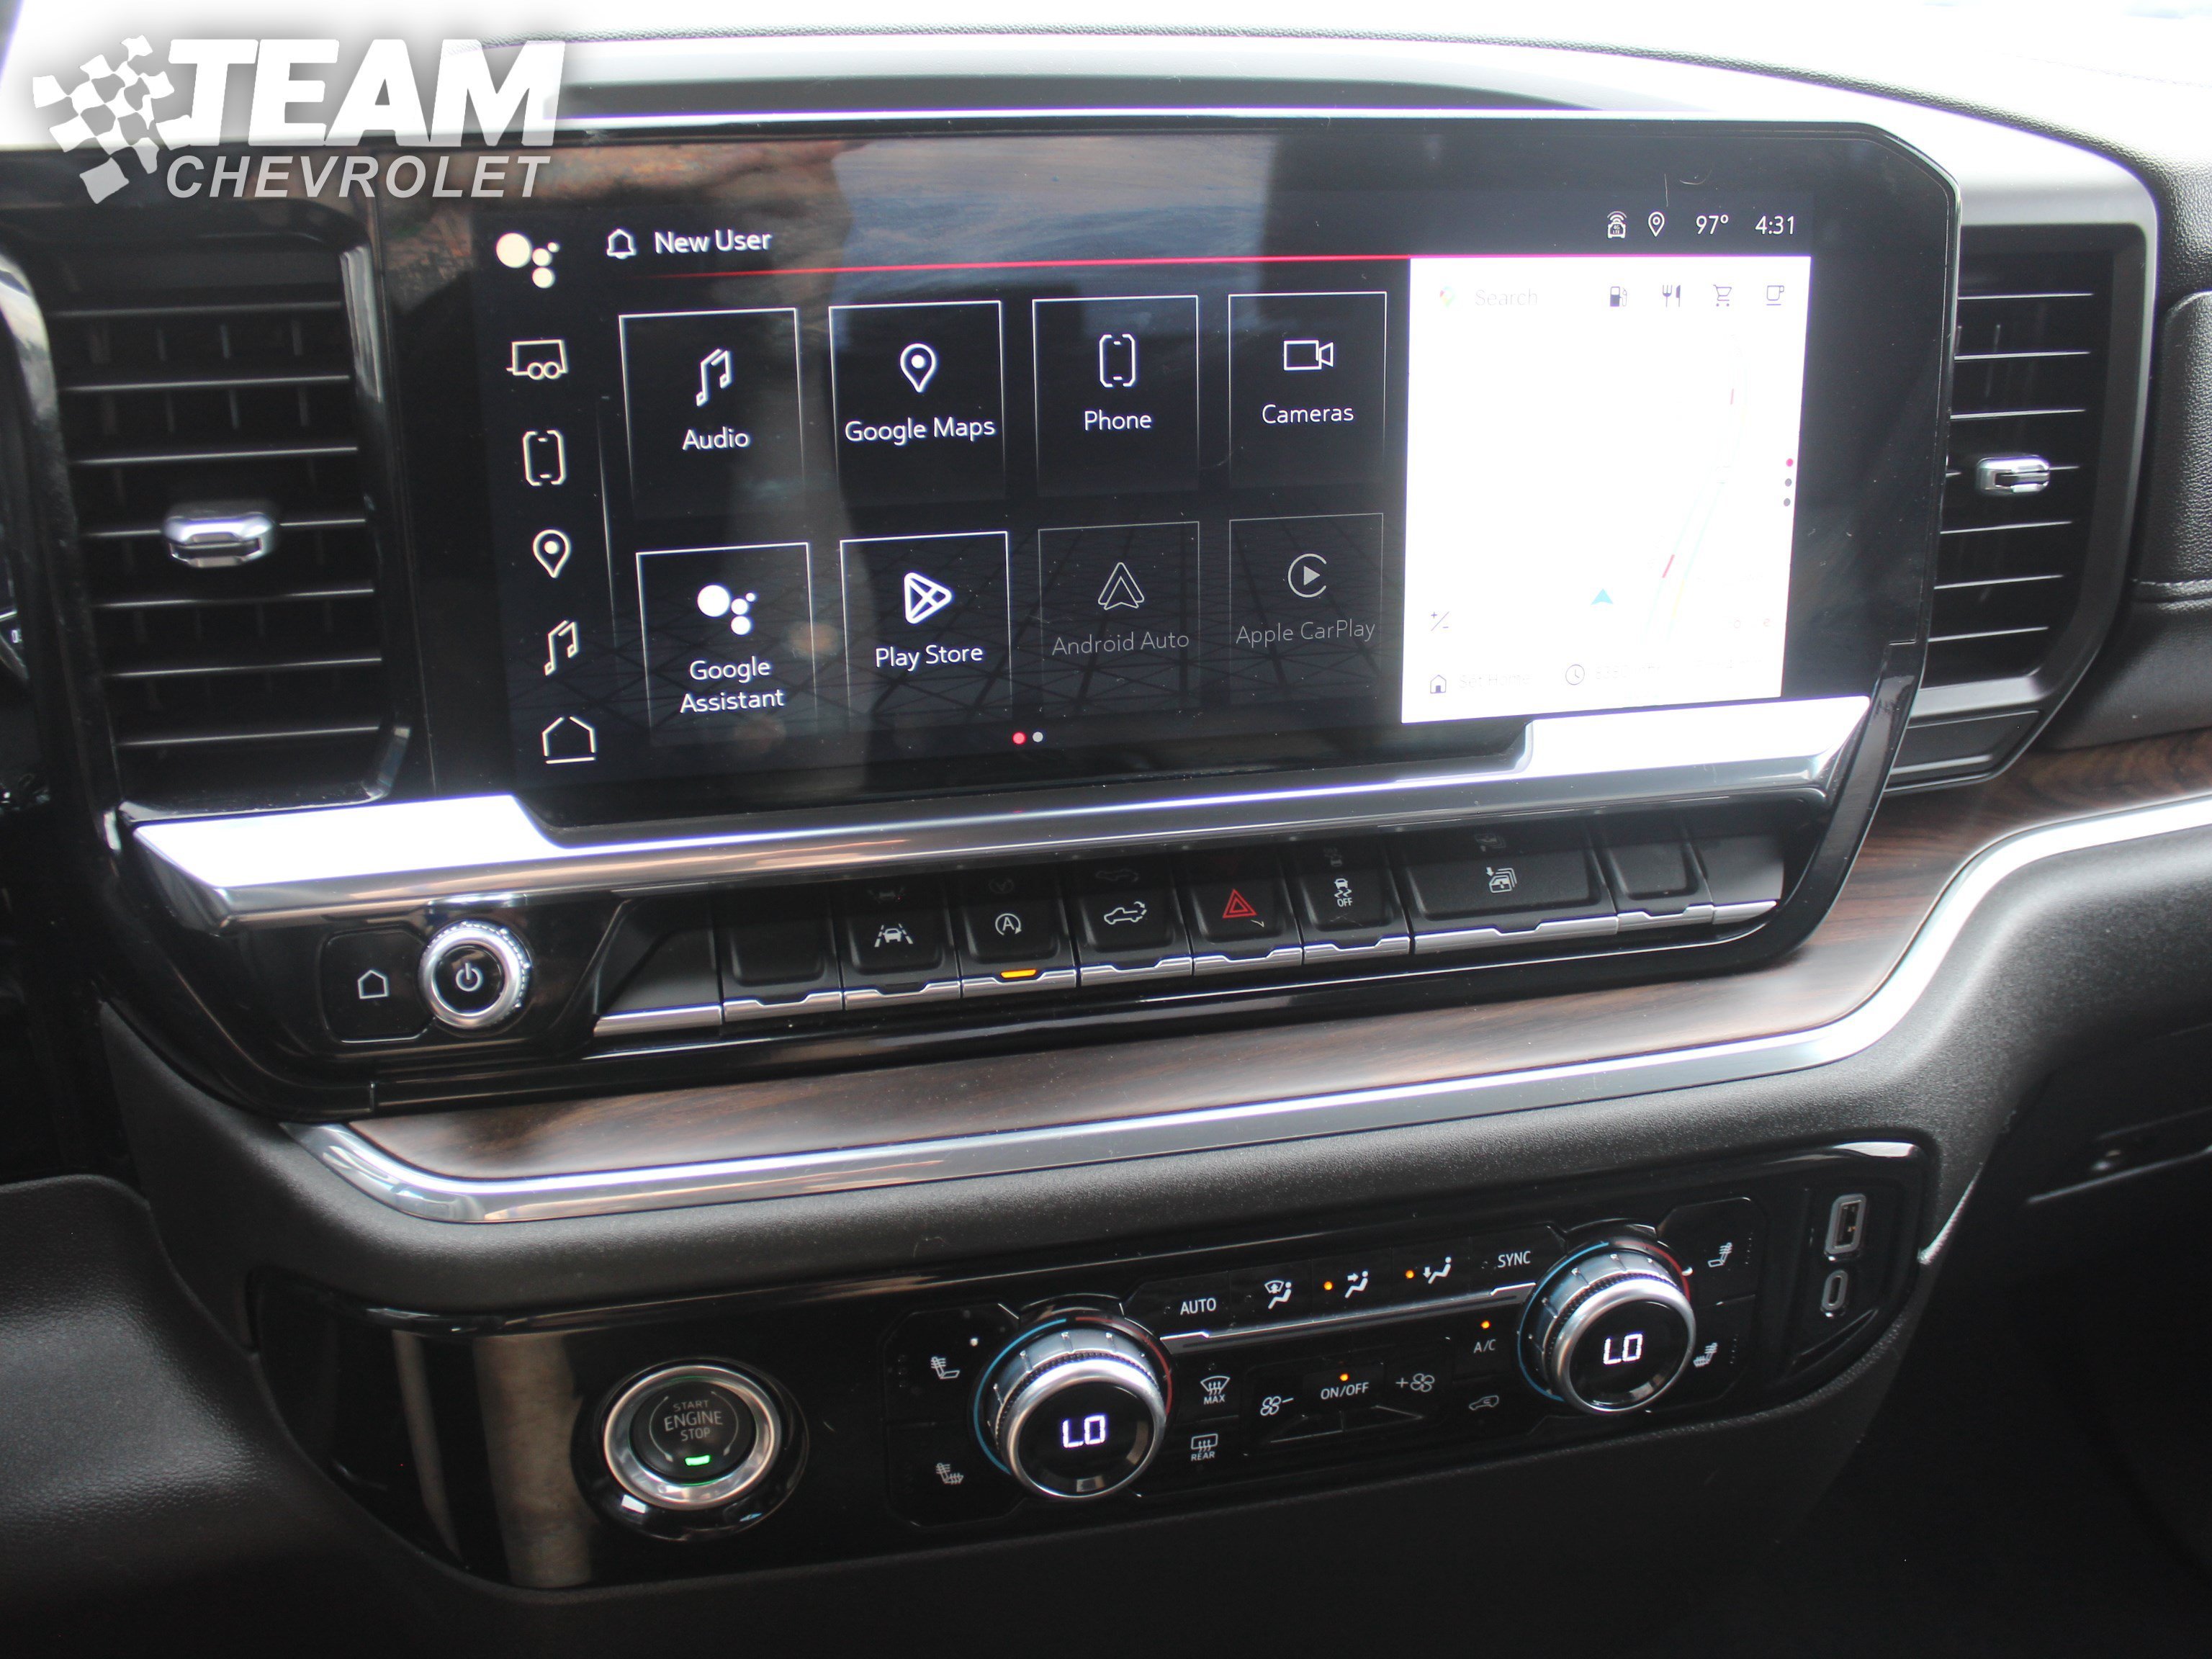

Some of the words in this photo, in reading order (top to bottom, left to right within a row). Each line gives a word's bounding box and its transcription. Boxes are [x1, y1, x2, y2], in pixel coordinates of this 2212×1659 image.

[1755, 215, 1794, 235] 4:31
[655, 231, 711, 254] New
[715, 229, 773, 251] User
[1475, 288, 1538, 306] Search
[1084, 409, 1152, 431] Phone
[1262, 404, 1354, 424] Cameras
[682, 426, 750, 451] Audio
[845, 417, 927, 446] Google
[933, 416, 996, 442] Maps
[1051, 631, 1134, 656] Android
[1140, 631, 1190, 650] Auto
[1236, 623, 1294, 649] Apple
[1300, 618, 1376, 642] CarPlay
[876, 646, 920, 672] Play
[925, 644, 984, 665] Store
[689, 655, 772, 683] Google
[680, 689, 785, 714] Assistant
[1336, 896, 1353, 907] OFF
[1497, 1250, 1531, 1268] SYNC
[1179, 1298, 1217, 1316] AUTO
[1473, 1339, 1496, 1354] A/C
[1603, 1333, 1643, 1365] LO
[1320, 1380, 1369, 1400] ON/OFF
[673, 1400, 709, 1411] START
[1202, 1395, 1226, 1406] MAX
[664, 1411, 723, 1431] ENGINE
[1062, 1414, 1106, 1448] LO
[680, 1427, 711, 1442] STOP
[1190, 1449, 1215, 1461] REAR
